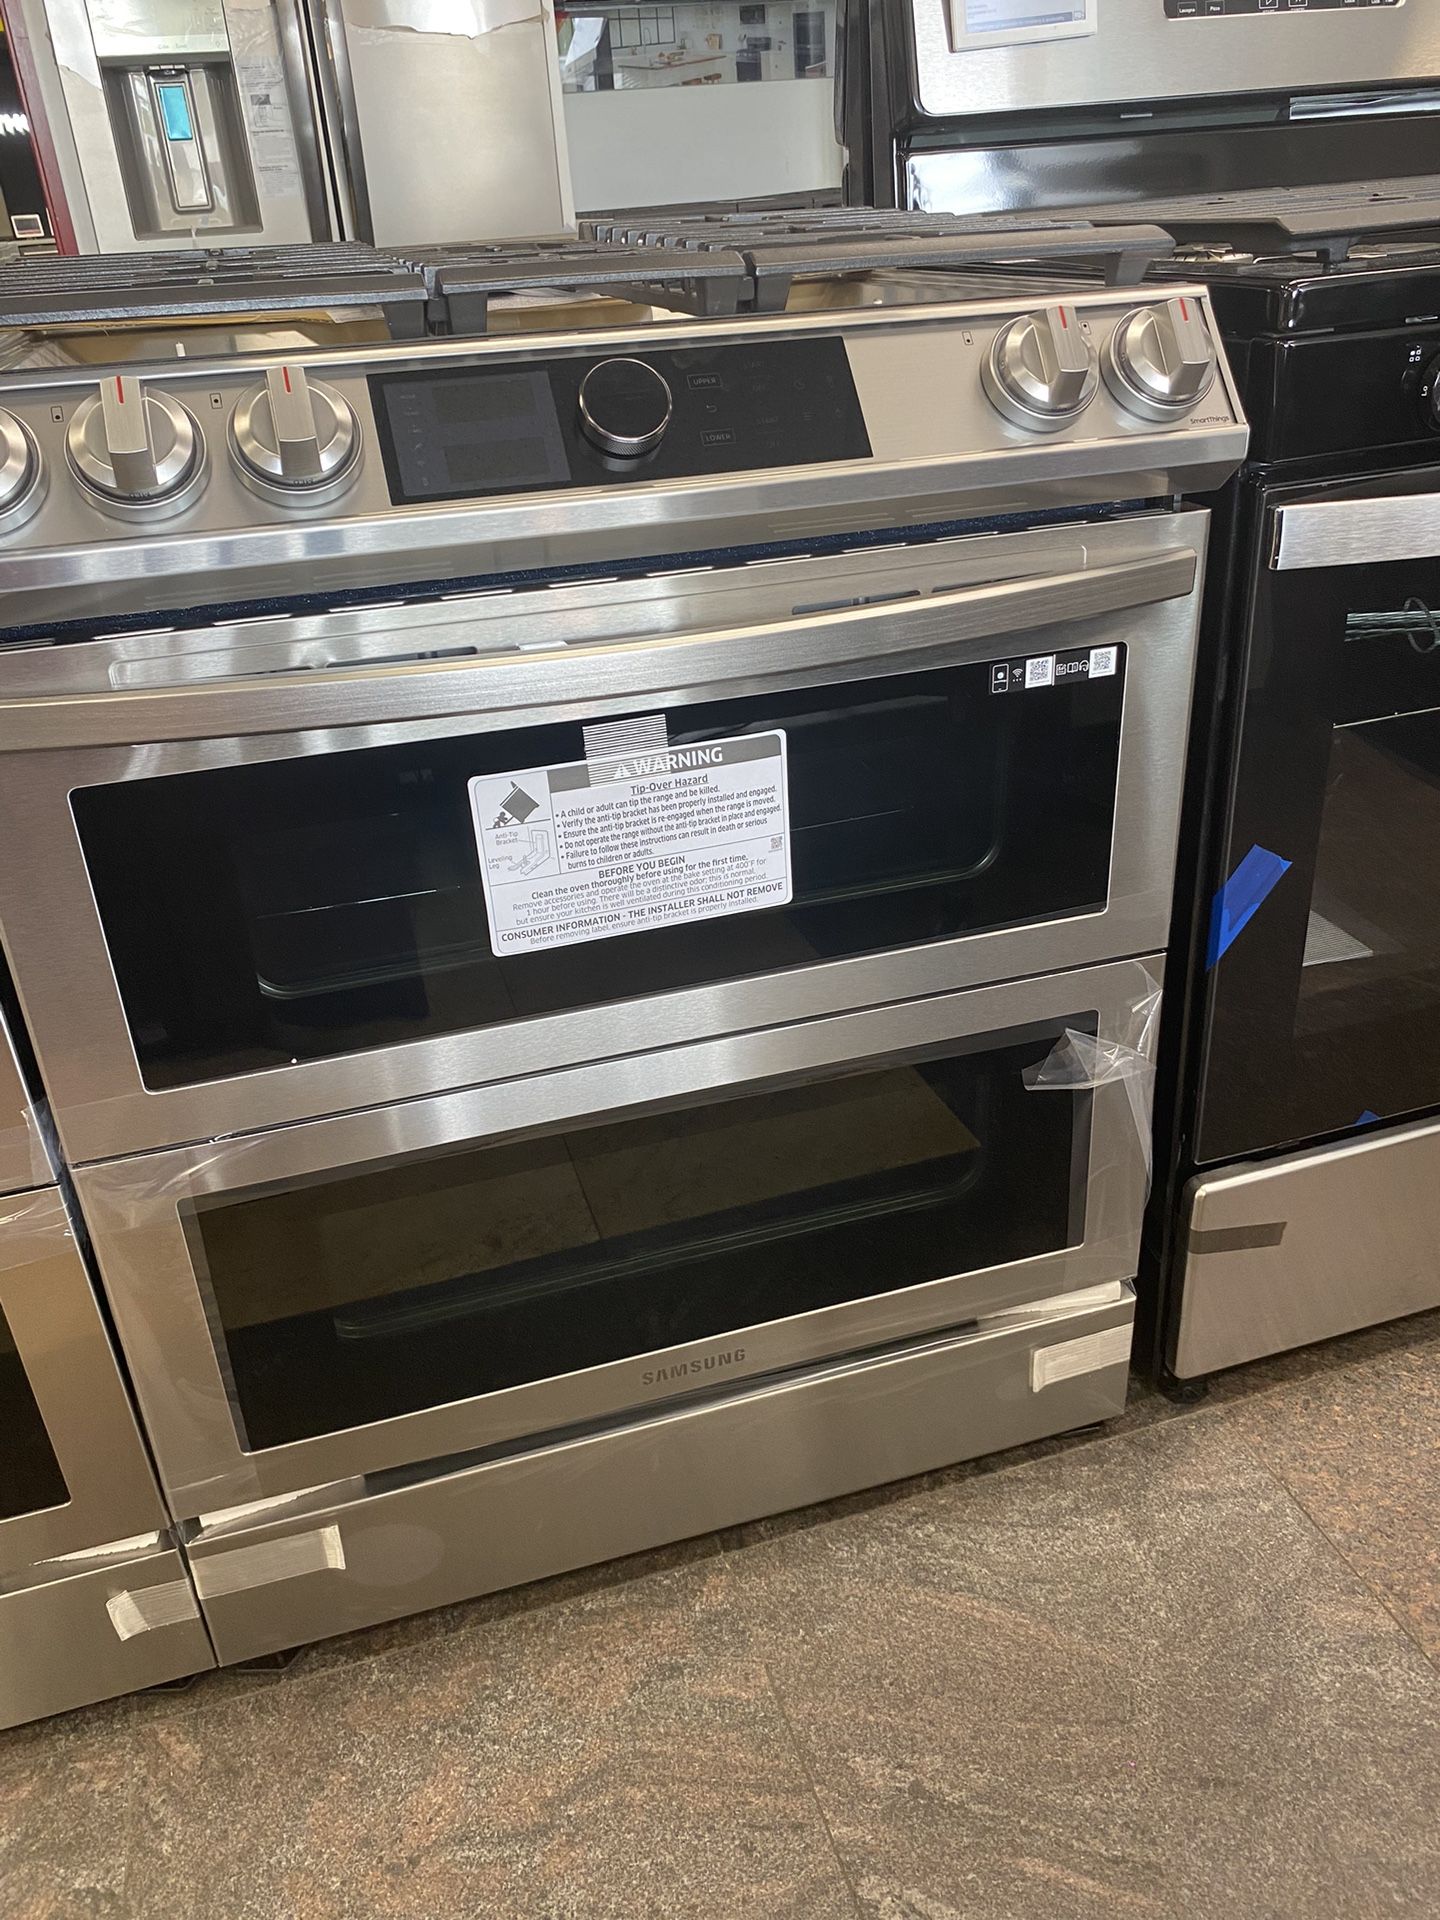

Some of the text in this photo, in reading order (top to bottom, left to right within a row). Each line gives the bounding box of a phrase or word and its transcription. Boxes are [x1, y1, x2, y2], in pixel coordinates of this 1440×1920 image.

[1190, 416, 1229, 424] SmartThings
[631, 746, 723, 775] WARNING
[567, 806, 585, 816] child
[595, 802, 614, 811] adult
[628, 798, 638, 807] tip
[639, 796, 651, 804] the
[652, 794, 673, 803] range
[674, 790, 687, 798] and
[689, 788, 698, 796] be
[698, 784, 720, 794] killed.
[630, 773, 708, 795] Tip-Over Hazard
[561, 785, 776, 829] Verify the anti-tip bracket has been properly installed and engaged.
[562, 827, 586, 838] Ensure
[587, 825, 598, 834] the
[599, 821, 624, 833] anti-tip
[625, 817, 650, 828] bracket
[657, 809, 694, 823] re-engaged
[695, 806, 713, 816] when
[714, 804, 725, 812] the
[726, 802, 745, 812] range
[752, 795, 775, 806] moved.
[564, 840, 573, 848] Do
[574, 838, 584, 847] not
[585, 834, 609, 846] operate
[610, 832, 620, 840] the
[621, 831, 639, 840] range
[639, 825, 663, 835] without
[664, 823, 674, 831] the
[675, 819, 697, 831] anti-tip
[697, 815, 720, 825] bracket
[727, 811, 743, 822] place
[744, 809, 755, 817] and
[755, 805, 781, 817] engaged.
[565, 848, 589, 859] Failure
[598, 843, 619, 853] follow
[620, 840, 638, 849] these
[639, 833, 677, 846] instructions
[690, 827, 709, 837] result
[717, 823, 735, 832] death
[744, 817, 767, 827] serious
[567, 859, 587, 869] burns
[596, 853, 623, 864] children
[632, 847, 654, 857] adults.
[512, 898, 542, 910] Remove
[543, 891, 584, 905] accessories
[585, 888, 599, 897] and
[600, 883, 628, 895] operate
[629, 880, 641, 889] the
[642, 878, 660, 886] oven
[670, 873, 681, 881] the
[683, 870, 700, 879] bake
[701, 865, 725, 877] setting
[756, 857, 766, 866] for
[531, 853, 748, 899] Clean the oven thoroughly before using for the first time.
[598, 855, 685, 878] BEFORE YOU BEGIN
[501, 925, 553, 942] CONSUMER
[555, 912, 620, 932] INFORMATION
[627, 907, 645, 918] THE
[647, 898, 695, 914] INSTALLER
[696, 892, 724, 905] SHALL
[726, 888, 744, 899] NOT
[746, 881, 782, 895] REMOVE
[515, 917, 528, 925] but
[529, 914, 554, 922] ensure
[556, 910, 572, 919] your
[574, 904, 600, 914] kitchen
[609, 899, 624, 908] well
[626, 892, 661, 904] ventilated
[662, 888, 685, 899] during
[686, 885, 699, 893] this
[701, 877, 743, 892] conditioning
[532, 905, 549, 914] hour
[551, 901, 575, 911] before
[599, 892, 619, 902] There
[620, 890, 634, 898] will
[651, 880, 688, 892] distinctive
[708, 874, 721, 882] this
[530, 934, 554, 944] Before
[555, 927, 589, 940] removing
[611, 920, 635, 929] ensure
[636, 913, 661, 925] anti-tip
[663, 908, 689, 919] bracket
[698, 901, 726, 913] properly
[641, 1348, 746, 1386] SAMSUNG
